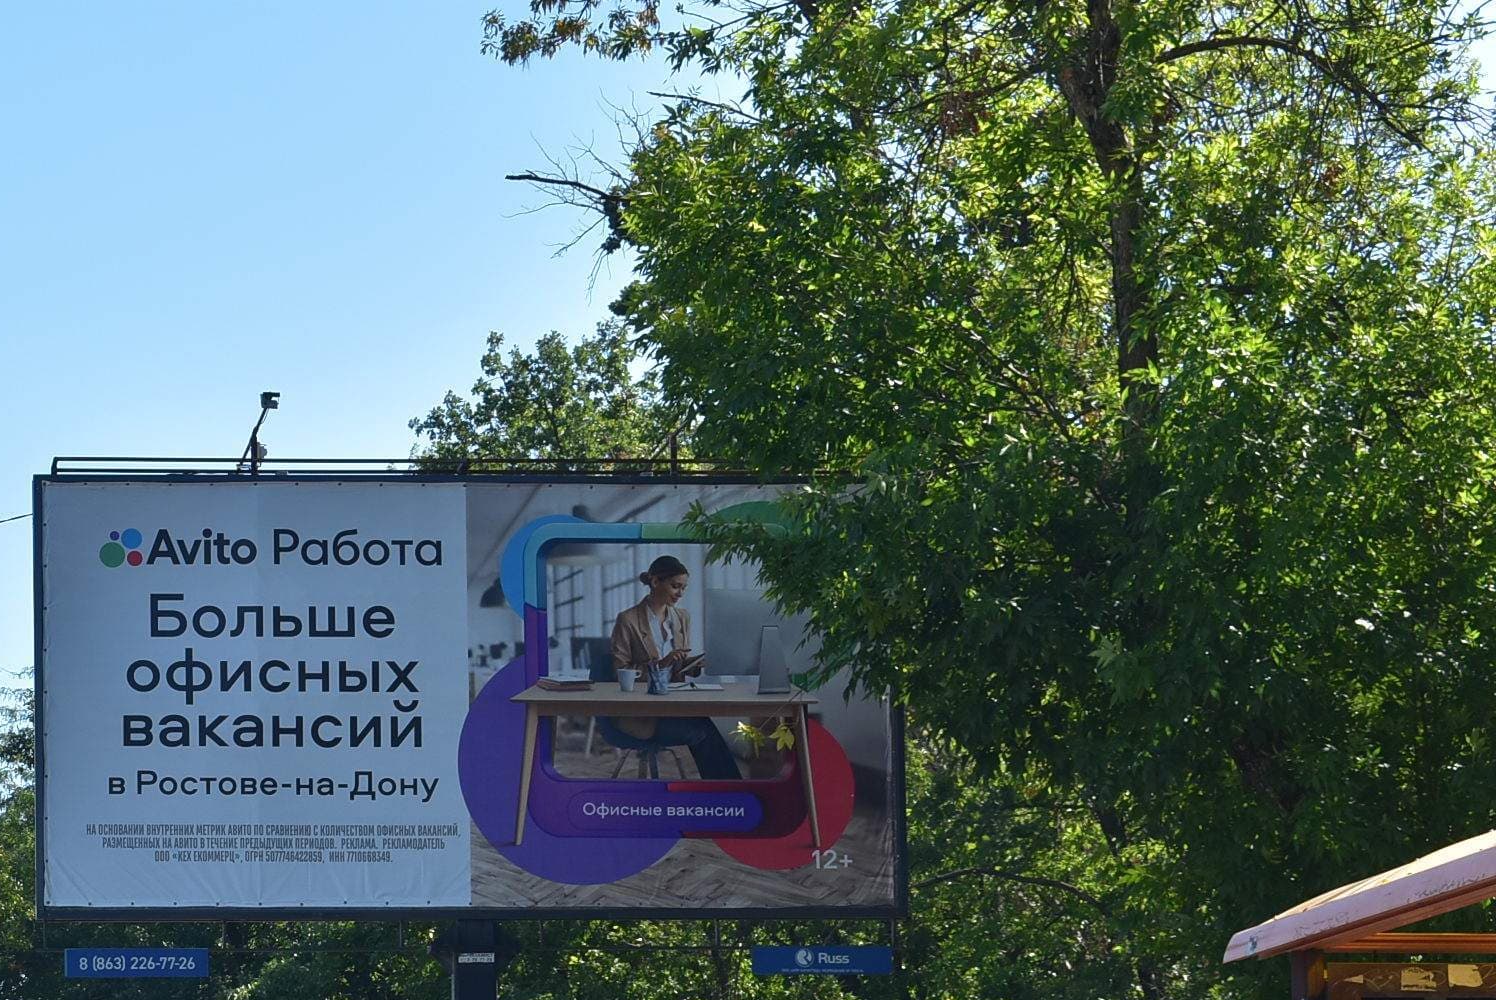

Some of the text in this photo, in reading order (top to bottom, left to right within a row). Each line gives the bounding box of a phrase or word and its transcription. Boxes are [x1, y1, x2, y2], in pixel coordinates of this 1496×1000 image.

[146, 527, 443, 567] Avito Работа
[149, 592, 396, 638] Больше
[125, 647, 420, 706] офисных
[122, 699, 423, 749] вакансий
[107, 769, 440, 803] в Ростове-на-Дону
[582, 801, 745, 820] Офисные вакансии
[86, 824, 97, 836] НА
[98, 824, 145, 836] ОСНОВАНИИ
[146, 824, 195, 836] ВНУТРЕННИХ
[196, 824, 226, 836] МЕТРИК
[228, 824, 252, 836] АВИТО
[254, 824, 264, 836] ПО
[266, 824, 312, 836] СРАВНЕНИЮ
[313, 824, 320, 836] С
[321, 824, 375, 836] КОЛИЧЕСТВОМ
[377, 824, 416, 836] ОФИСНЫХ
[103, 838, 161, 850] РАЗМЕЩЕННЫХ
[162, 838, 172, 850] НА
[174, 838, 198, 850] АВИТО
[206, 838, 238, 850] ТЕЧЕНИЕ
[240, 838, 294, 850] ПРЕДЫДУЩИХ
[295, 838, 337, 850] ПЕРИОДОВ.
[382, 838, 446, 850] РЕКЛАМОДАТЕЛЬ
[154, 851, 170, 863] ООО
[244, 851, 264, 863] ОГРН
[329, 851, 345, 863] ИНН
[810, 849, 854, 870] 12+
[79, 955, 196, 972] 8 (863) 226-77-26
[817, 952, 851, 965] Russ
